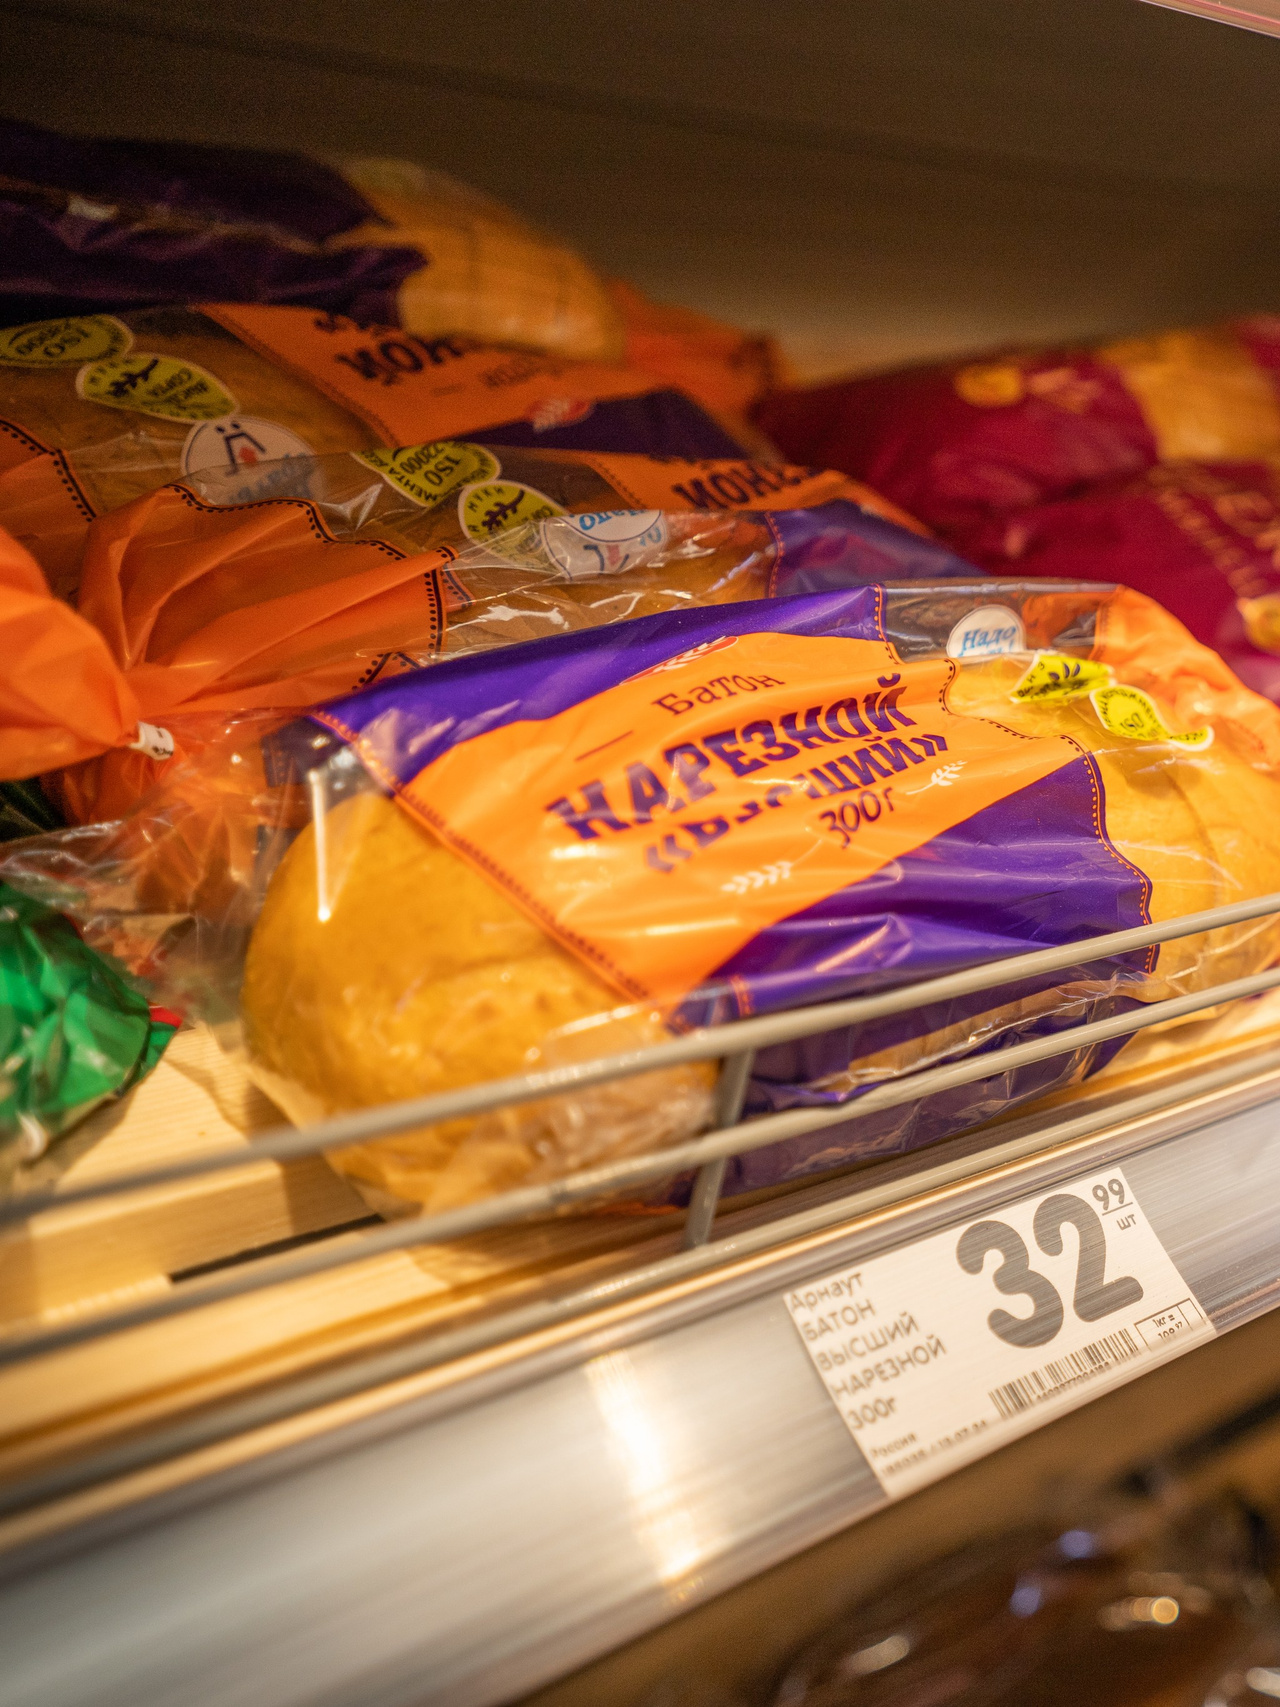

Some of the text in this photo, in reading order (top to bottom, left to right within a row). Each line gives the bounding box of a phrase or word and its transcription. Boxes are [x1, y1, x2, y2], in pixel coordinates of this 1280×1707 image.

[424, 455, 461, 487] ISO
[961, 624, 1017, 651] Надо
[545, 673, 917, 840] НАРЕЗНОЙ
[819, 783, 895, 850] 300г
[956, 1193, 1144, 1348] 32
[1091, 1178, 1125, 1211] 99
[790, 1272, 863, 1314] Арнаут
[801, 1298, 877, 1342] БАТОН
[815, 1311, 920, 1372] ВЫСШИЙ
[830, 1333, 948, 1400] НАРЕЗНОЙ
[848, 1396, 897, 1430] 300г
